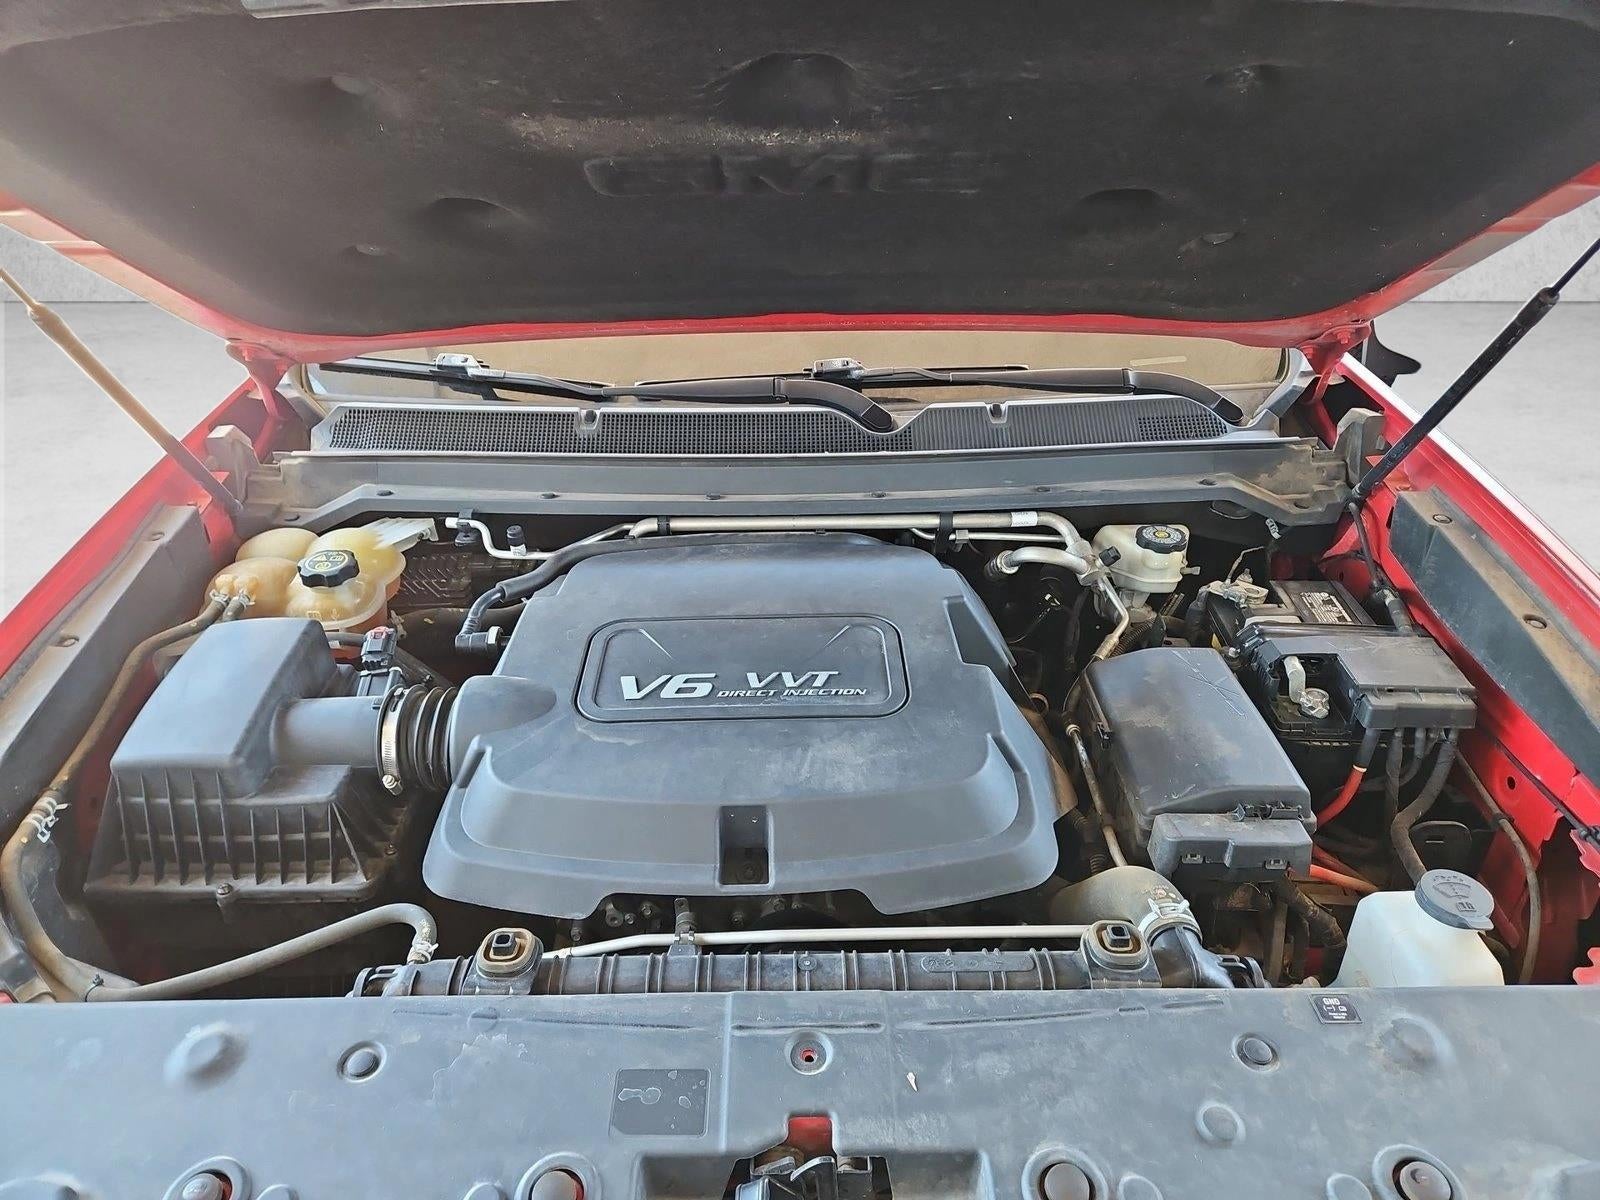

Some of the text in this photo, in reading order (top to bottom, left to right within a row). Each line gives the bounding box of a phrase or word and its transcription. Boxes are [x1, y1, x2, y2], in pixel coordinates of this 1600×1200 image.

[620, 672, 716, 700] V6
[746, 671, 838, 688] VVT
[716, 688, 868, 698] DIRECT INJECTION
